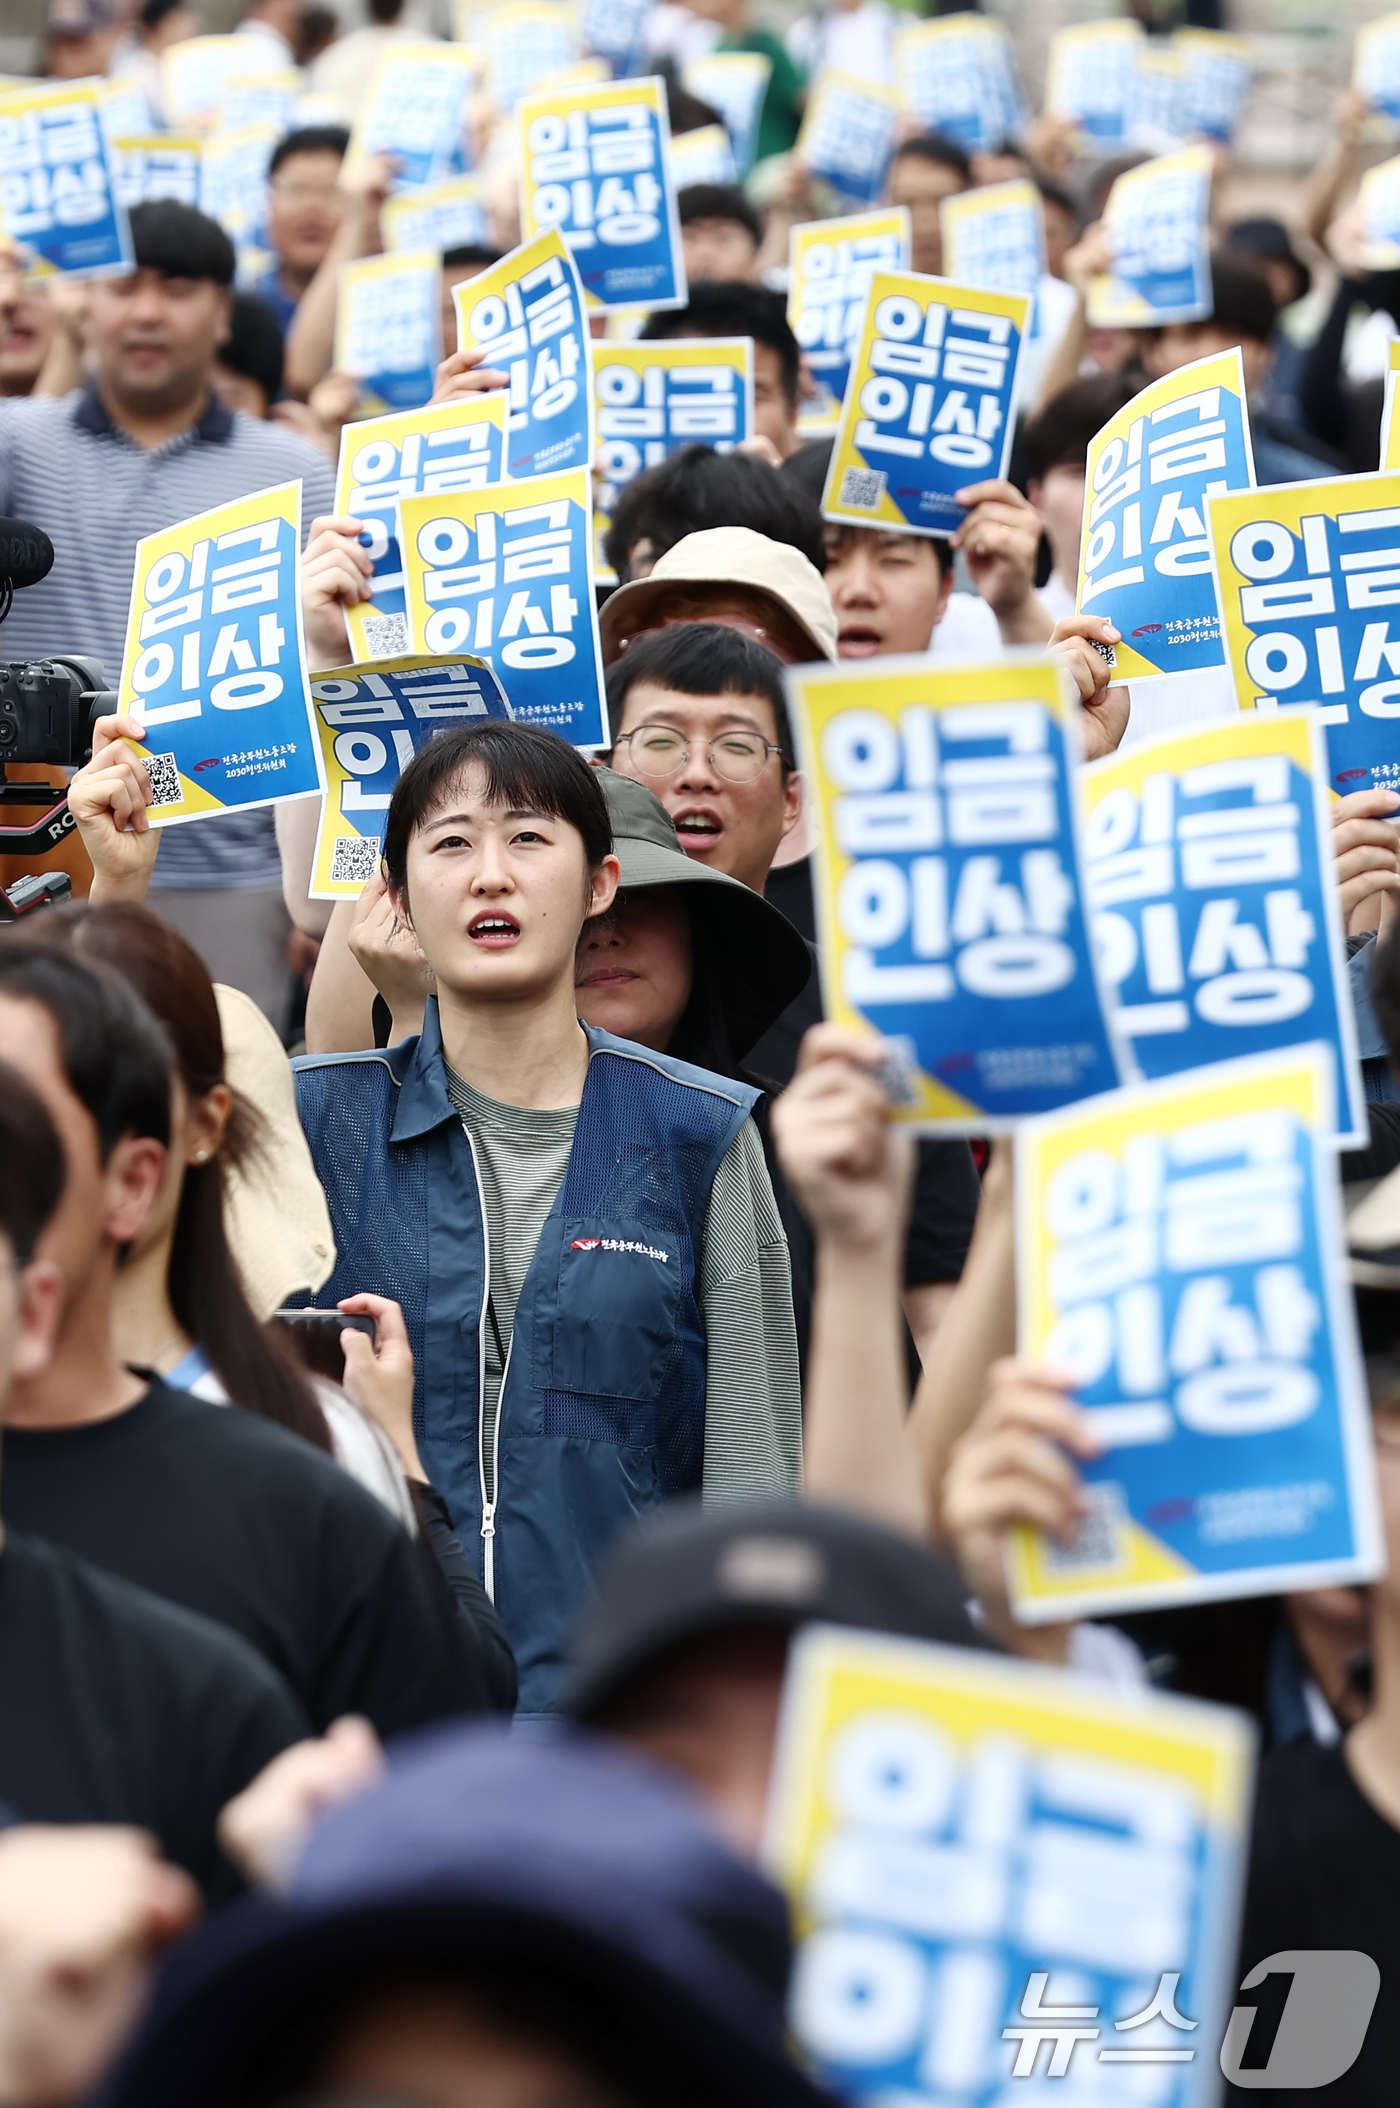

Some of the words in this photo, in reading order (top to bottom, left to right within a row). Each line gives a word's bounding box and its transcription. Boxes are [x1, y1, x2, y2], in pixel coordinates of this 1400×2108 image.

[528, 104, 655, 184] 임금
[531, 172, 662, 250] 인상
[470, 256, 574, 363] 임금
[870, 294, 1014, 389] 임금
[596, 363, 738, 436] 임금
[854, 375, 1002, 468] 인상
[352, 421, 492, 514] 임금
[1090, 386, 1227, 530] 임금
[144, 517, 283, 642] 임금
[417, 498, 573, 602] 임금
[129, 612, 286, 728] 인상
[311, 664, 489, 725] 임금
[222, 742, 297, 766] 전국공무원노동조합
[225, 758, 286, 778] 2030청년위원회
[821, 701, 1057, 854] 임금
[1082, 754, 1300, 902] 임금
[839, 849, 1077, 1005] 인상
[1094, 888, 1316, 1037] 인상
[1047, 1109, 1303, 1314] 임금
[1043, 1264, 1322, 1448] 인상
[814, 1706, 1195, 1975] 임금
